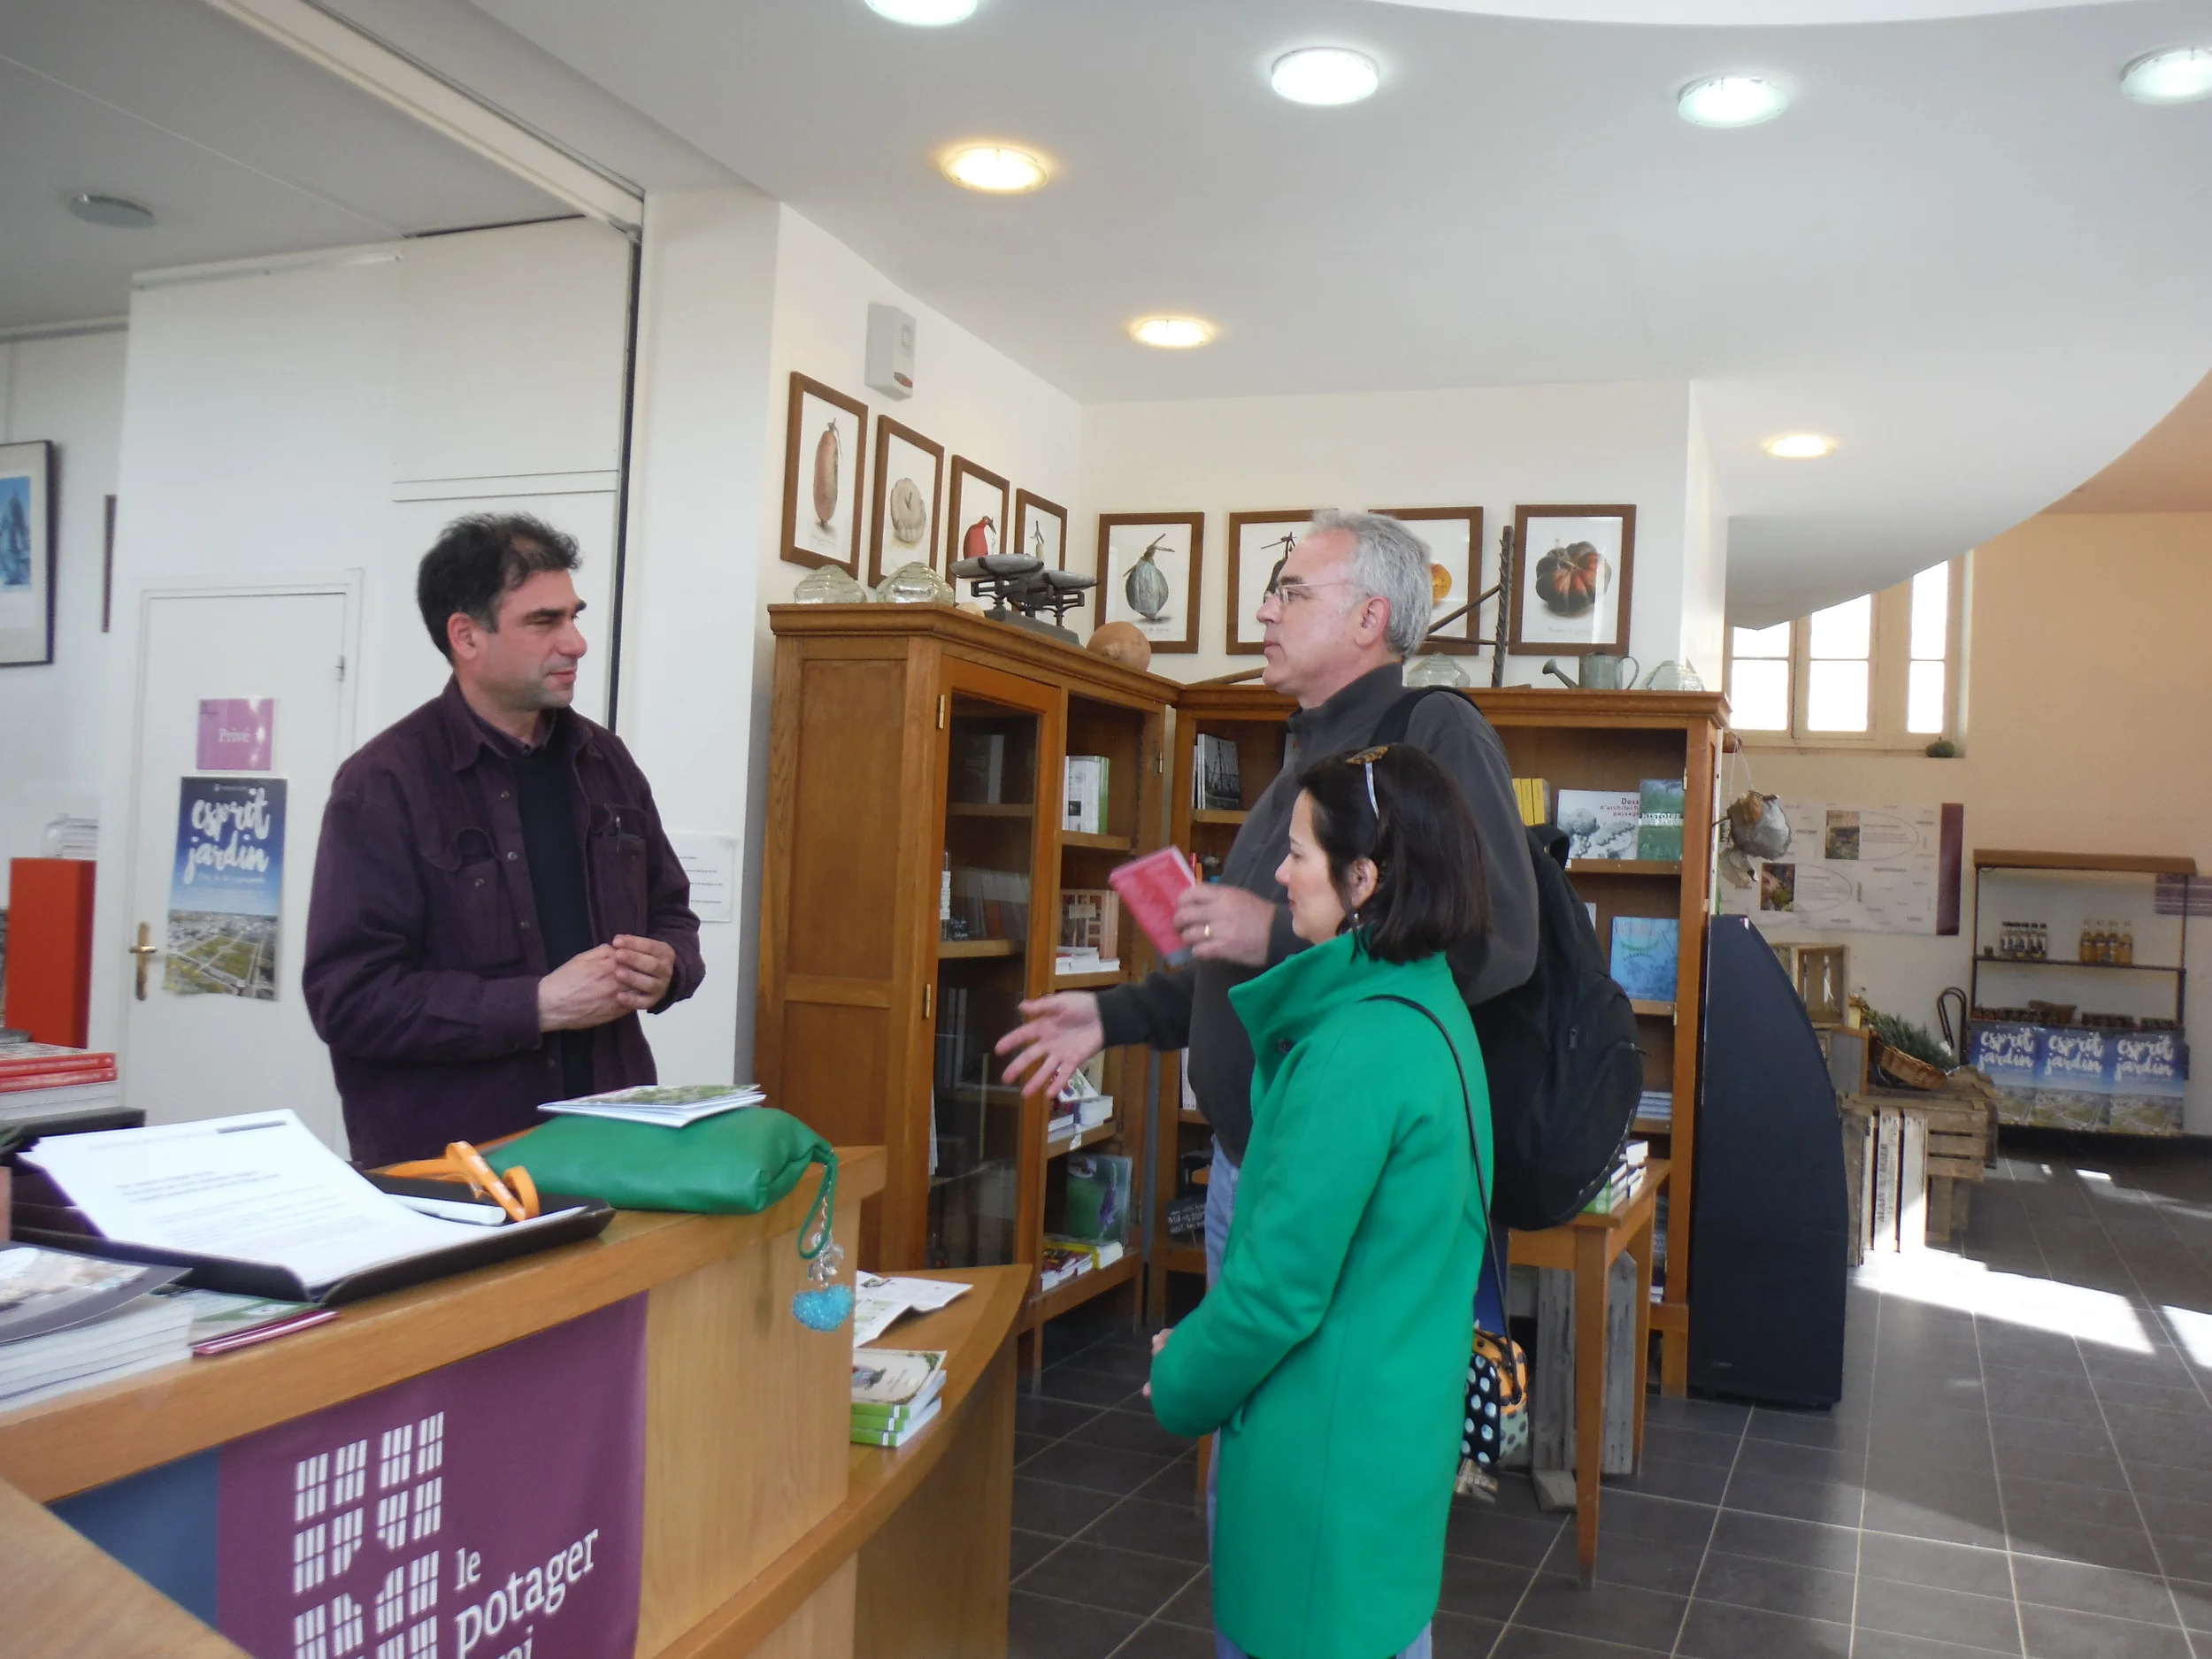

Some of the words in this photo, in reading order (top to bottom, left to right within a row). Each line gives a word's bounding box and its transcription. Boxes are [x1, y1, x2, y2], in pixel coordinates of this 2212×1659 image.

[219, 727, 250, 742] Privé
[191, 787, 271, 841] esprit
[183, 830, 270, 885] jardin
[1980, 1026, 2035, 1056] esprit
[2047, 1032, 2105, 1059] esprit
[2116, 1035, 2175, 1062] esprit
[1977, 1048, 2035, 1071] jardin
[2044, 1051, 2103, 1076] jardin
[2114, 1056, 2175, 1080] jardin
[454, 1548, 481, 1591] le
[454, 1528, 599, 1659] potager
